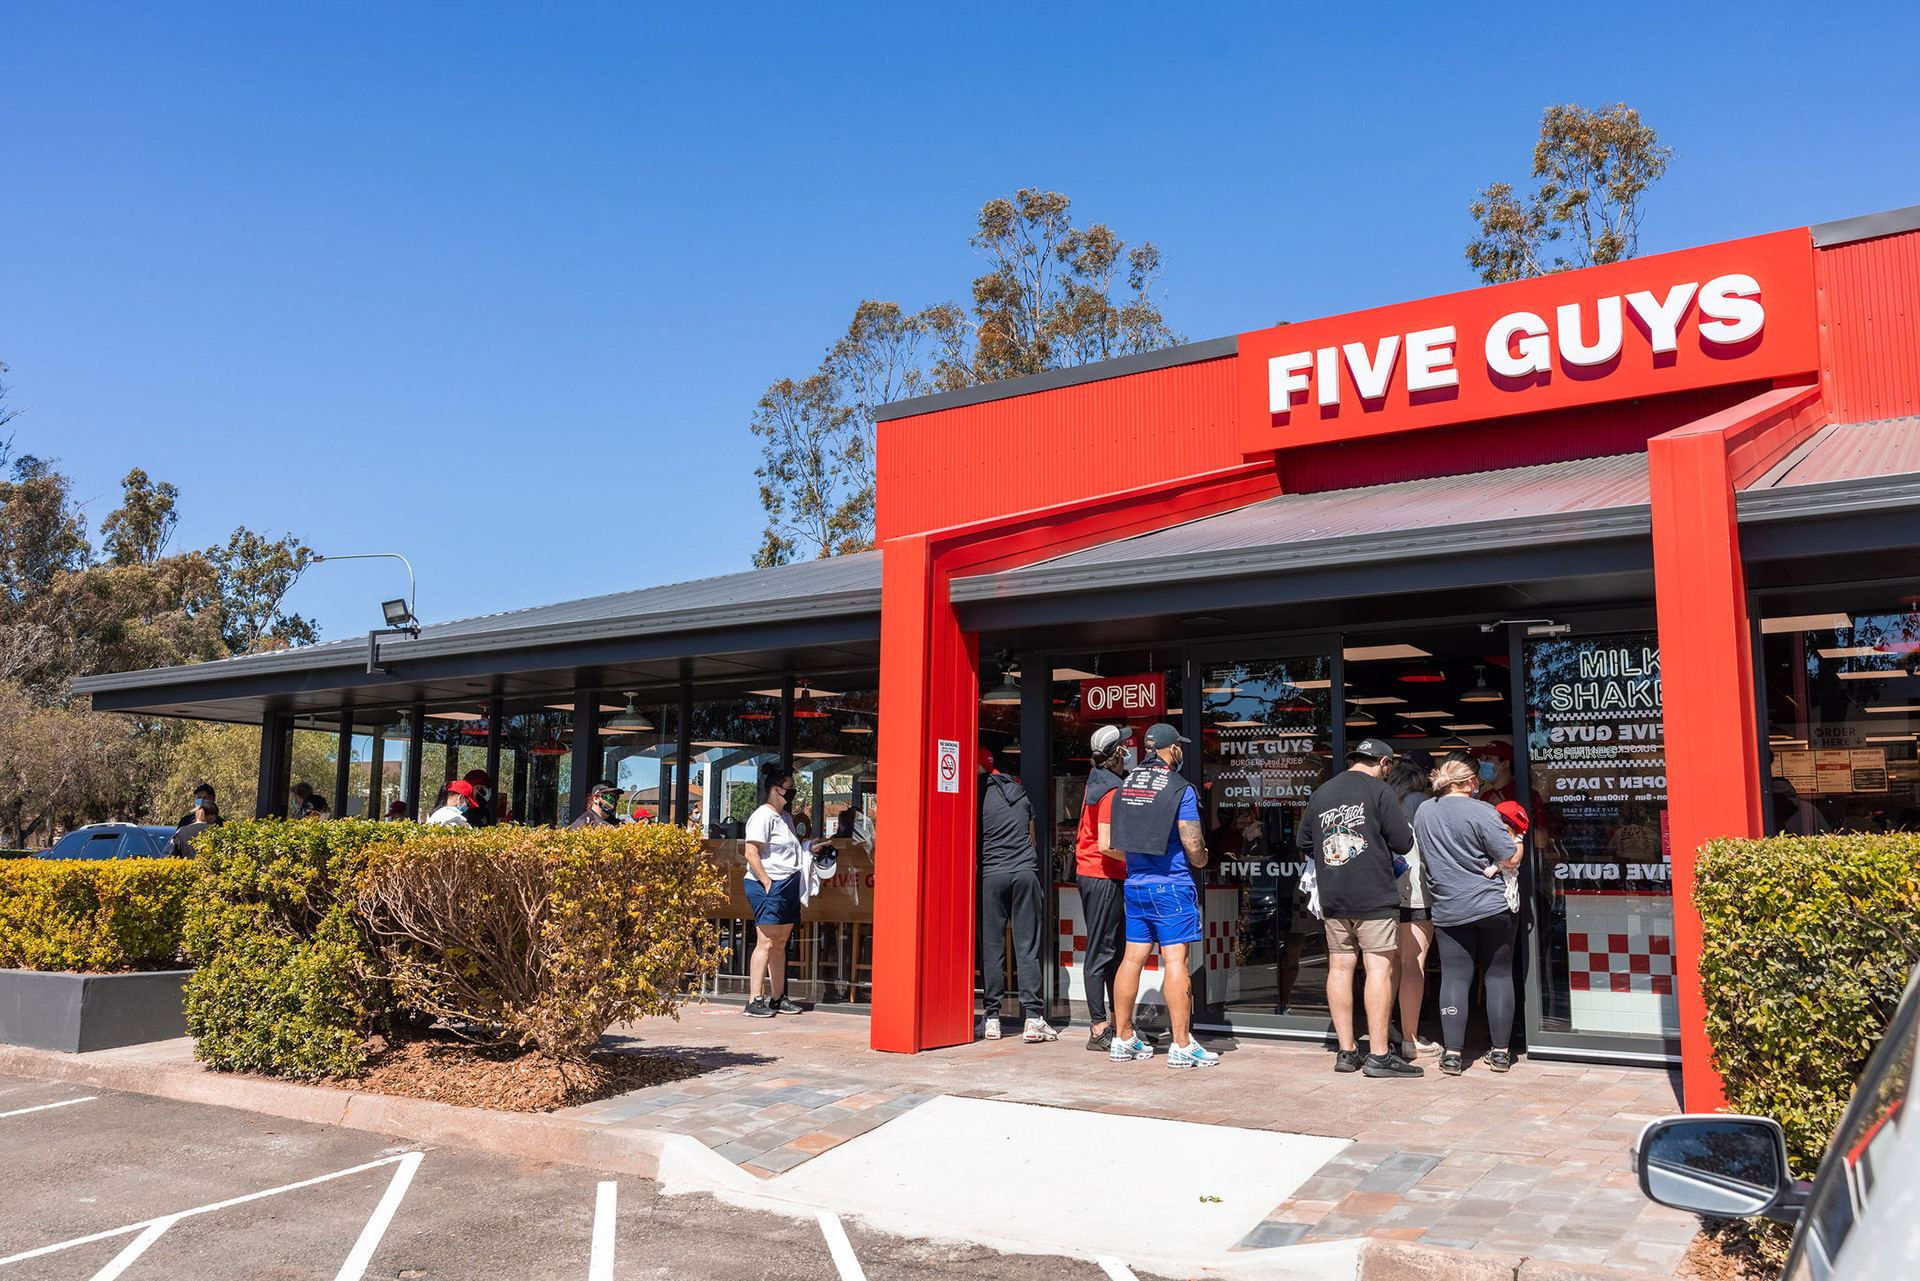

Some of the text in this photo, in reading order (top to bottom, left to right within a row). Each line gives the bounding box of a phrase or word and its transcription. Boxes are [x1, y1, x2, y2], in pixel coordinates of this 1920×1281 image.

[1268, 274, 1765, 414] FIVE GUYS
[1579, 647, 1661, 679] MILK
[1087, 682, 1156, 711] OPEN
[1815, 727, 1856, 738] ORDER
[1220, 739, 1313, 756] FIVE GUYS
[1822, 738, 1850, 747] HERE
[1529, 744, 1617, 761] ILKSHAKES
[1230, 758, 1265, 766] BURGERS
[1281, 757, 1304, 766] FRIES
[1224, 785, 1312, 798] OPEN 7 DAYS
[1221, 861, 1307, 877] FIVE GUY
